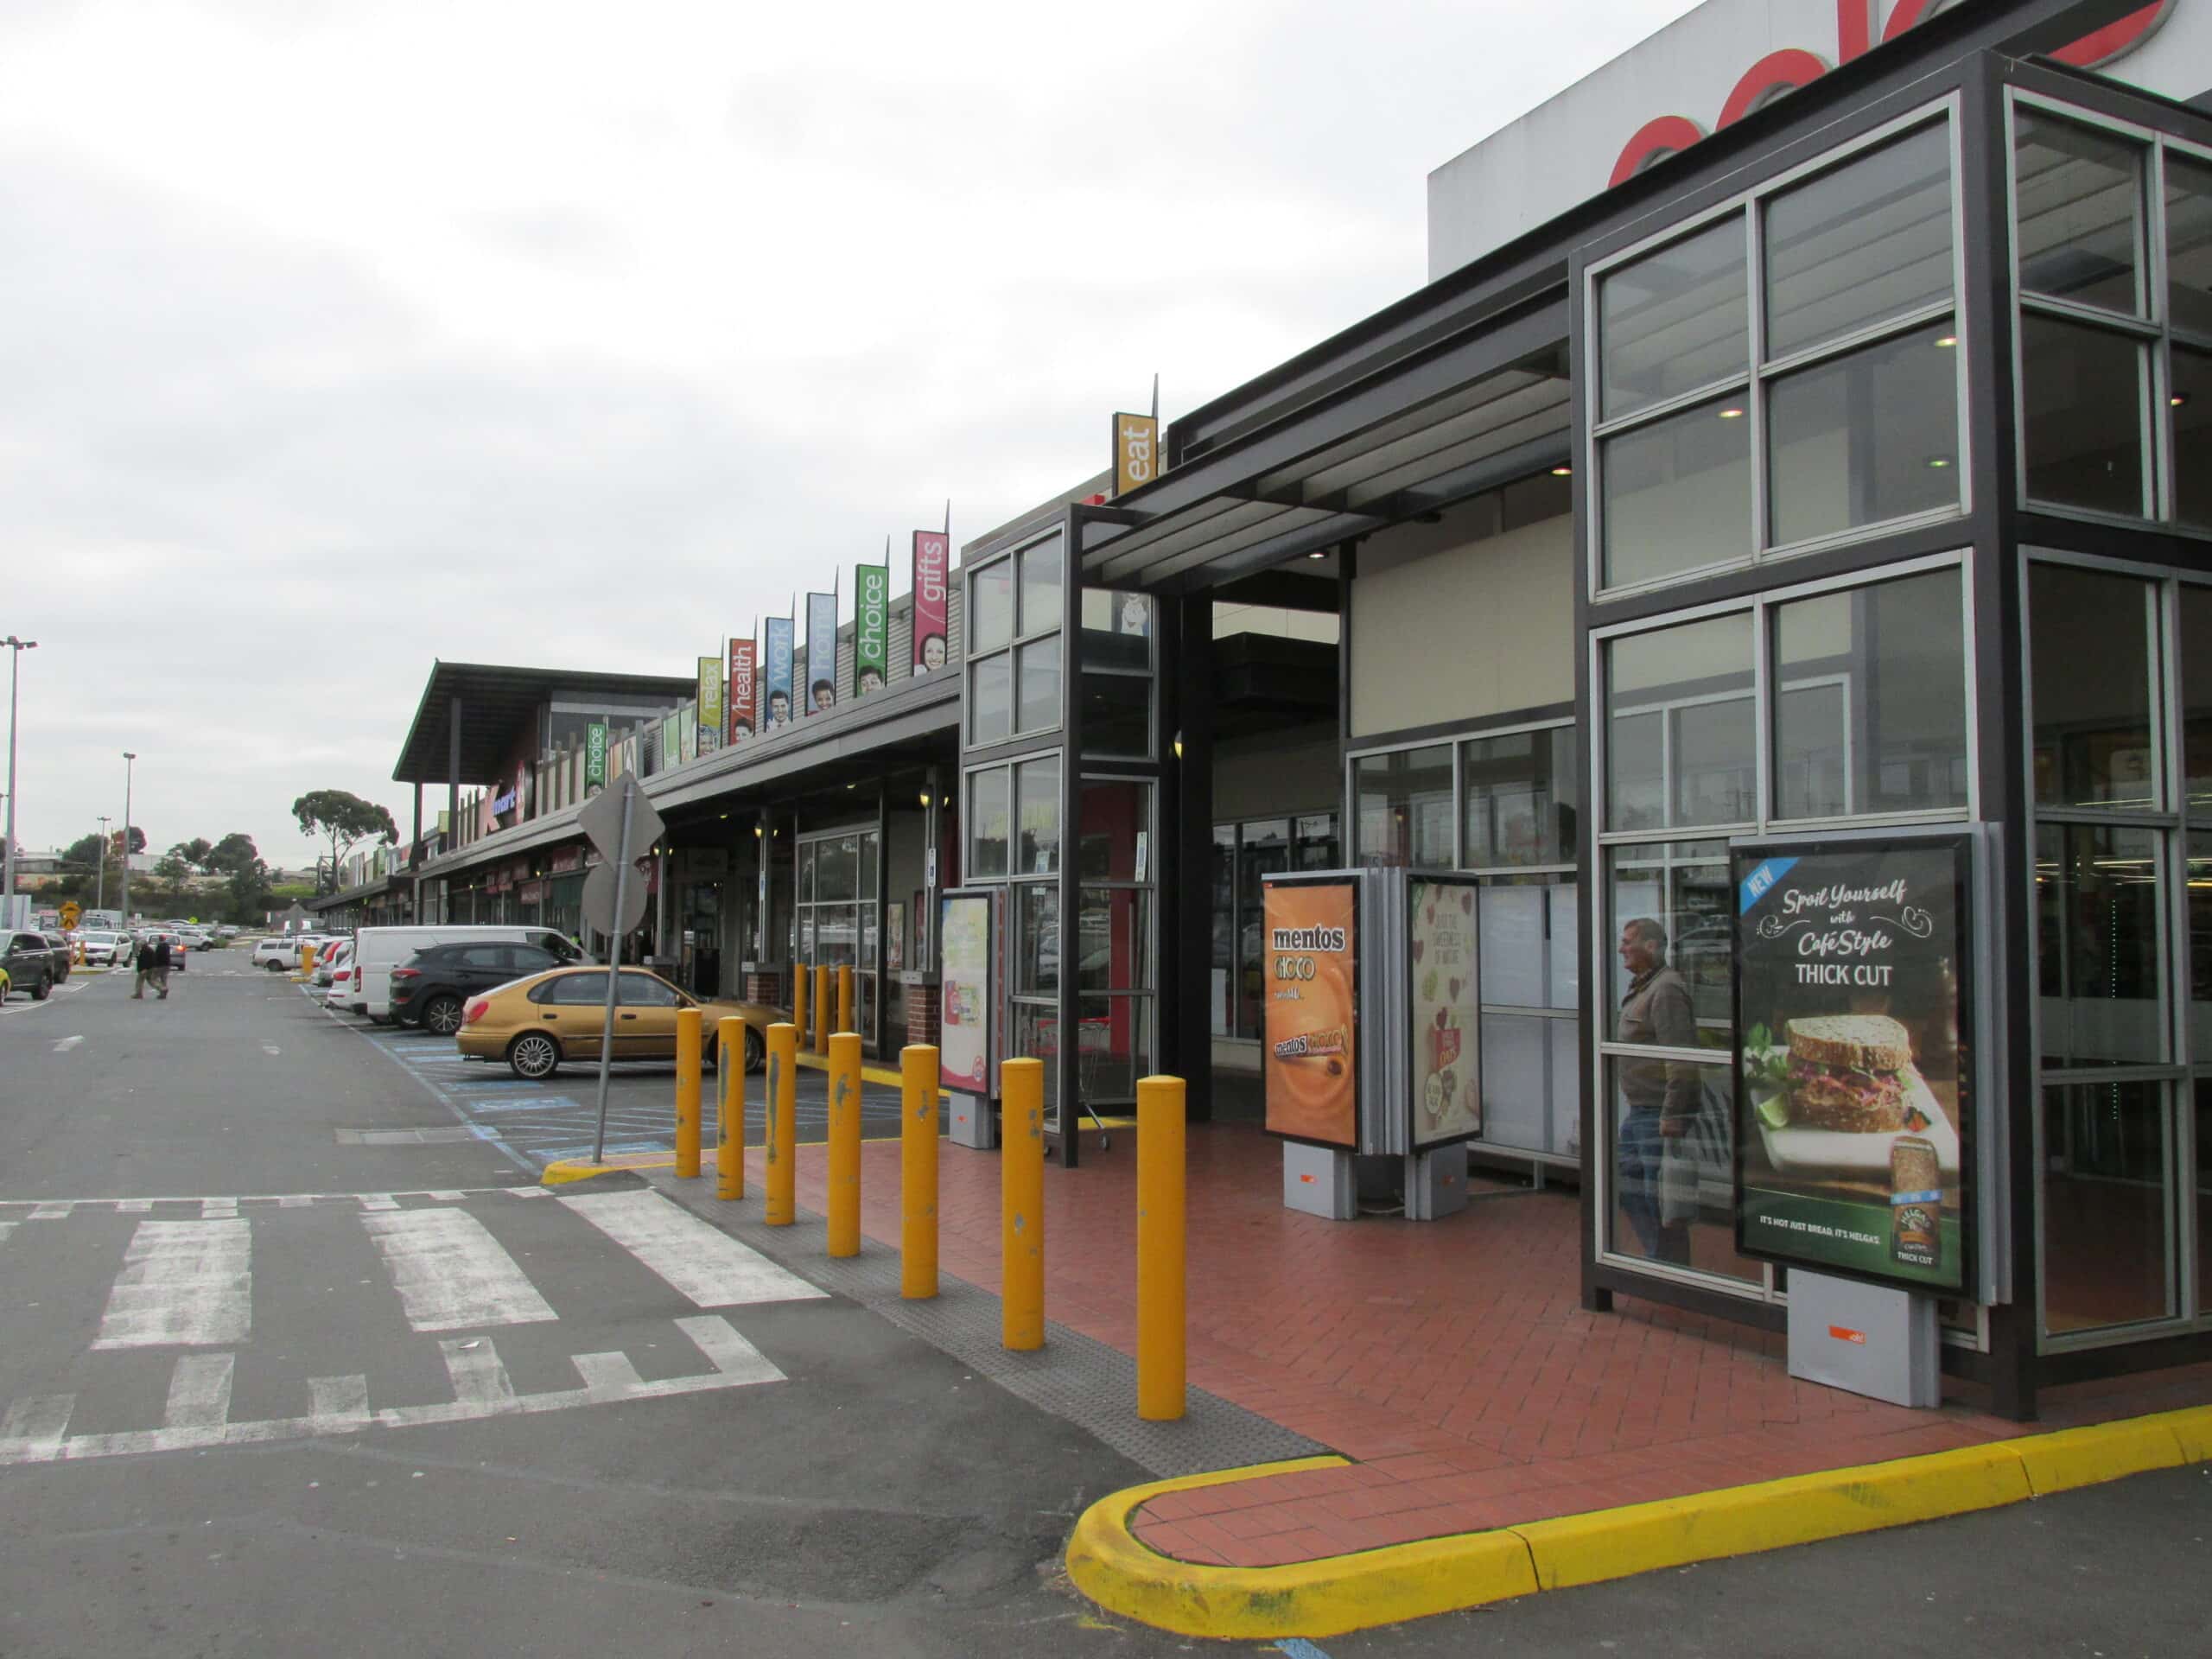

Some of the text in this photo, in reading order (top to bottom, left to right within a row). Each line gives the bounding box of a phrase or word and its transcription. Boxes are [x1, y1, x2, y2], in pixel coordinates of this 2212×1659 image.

[1124, 426, 1150, 481] eat
[917, 541, 946, 601] gifts
[811, 597, 831, 671] hom
[859, 574, 883, 658] choice
[772, 624, 789, 683] work
[703, 663, 719, 709] relax
[733, 645, 753, 710] health
[588, 728, 603, 777] choice
[1747, 865, 1774, 897] NEW
[1782, 879, 1908, 914] Spoil Yourself
[1829, 911, 1856, 924] with
[1273, 925, 1344, 951] mentos
[1797, 929, 1892, 957] Café Style
[1274, 955, 1316, 981] CHOCO
[1795, 963, 1892, 986] THICK CUT
[1275, 1035, 1306, 1056] mentos
